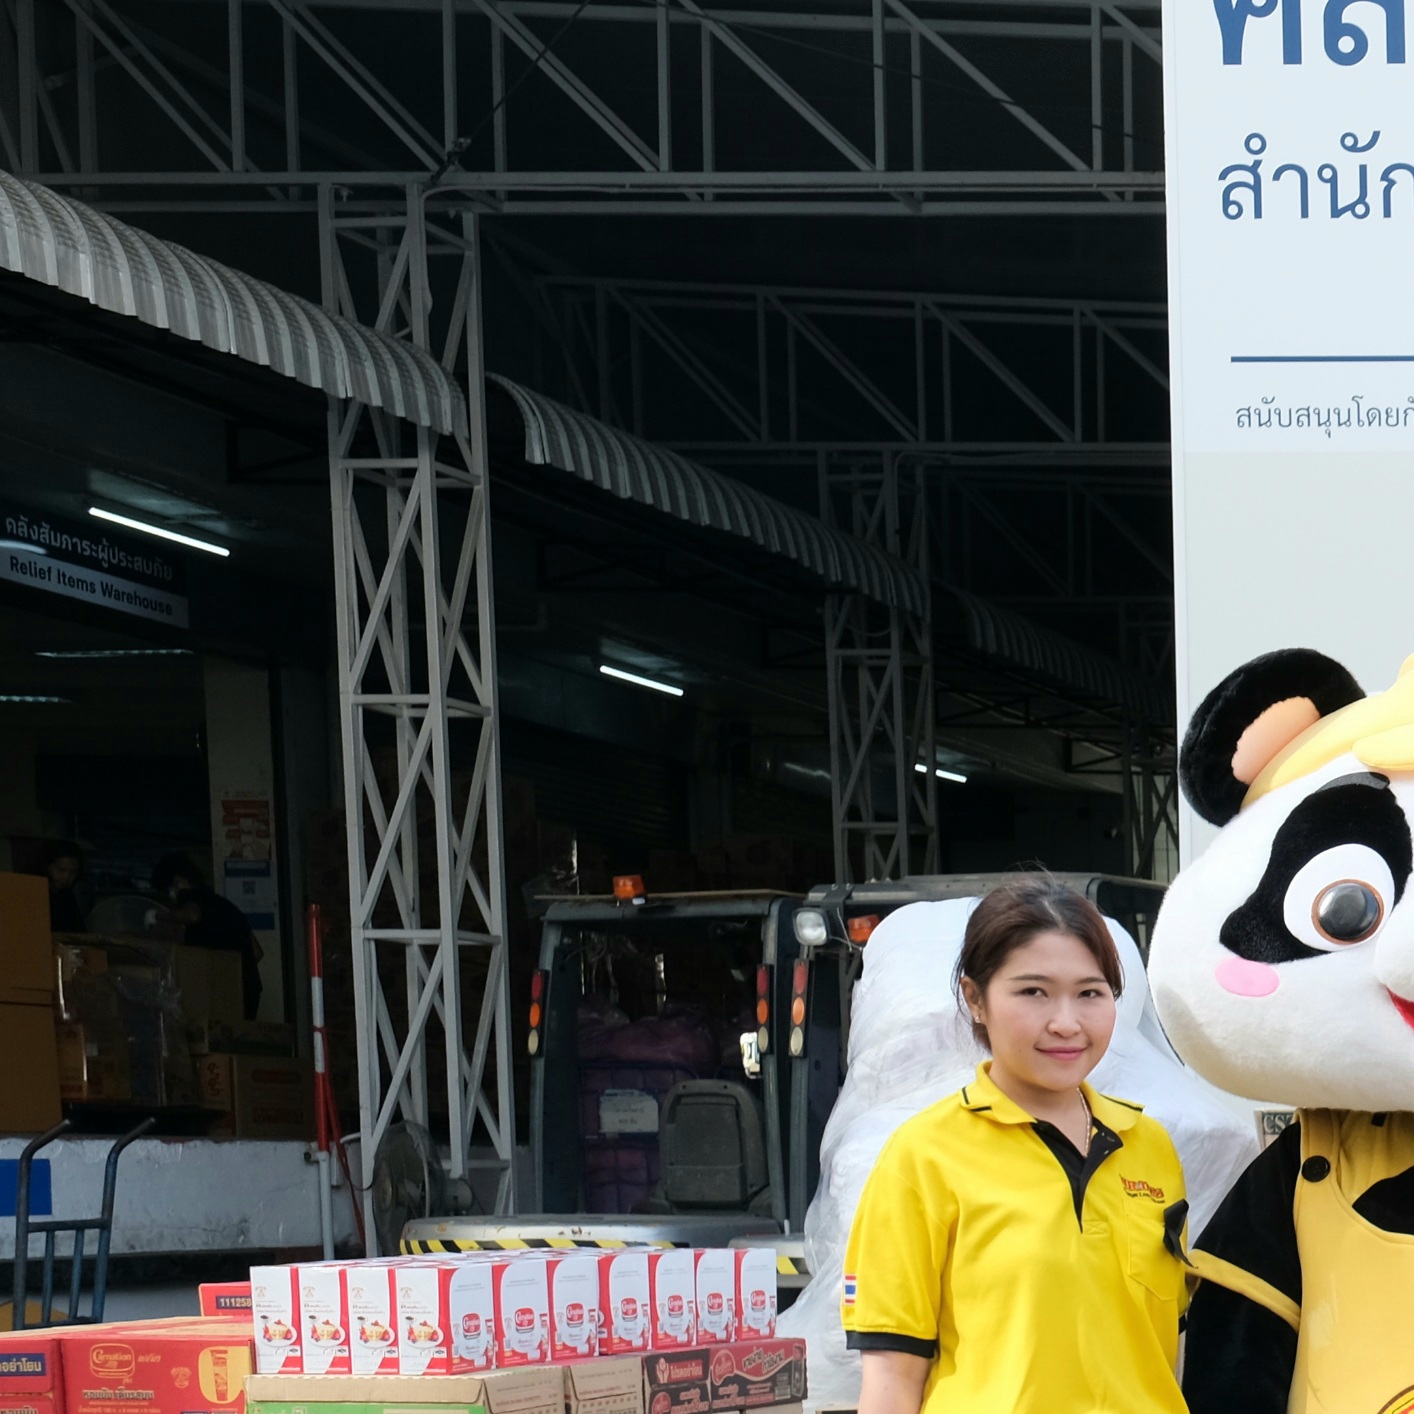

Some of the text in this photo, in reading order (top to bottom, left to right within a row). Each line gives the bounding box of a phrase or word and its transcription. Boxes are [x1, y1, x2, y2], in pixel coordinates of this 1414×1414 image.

[5, 514, 173, 582] คลังสัมภาระผู้ประสบภัย
[9, 555, 173, 617] Relief Items Warehouse
